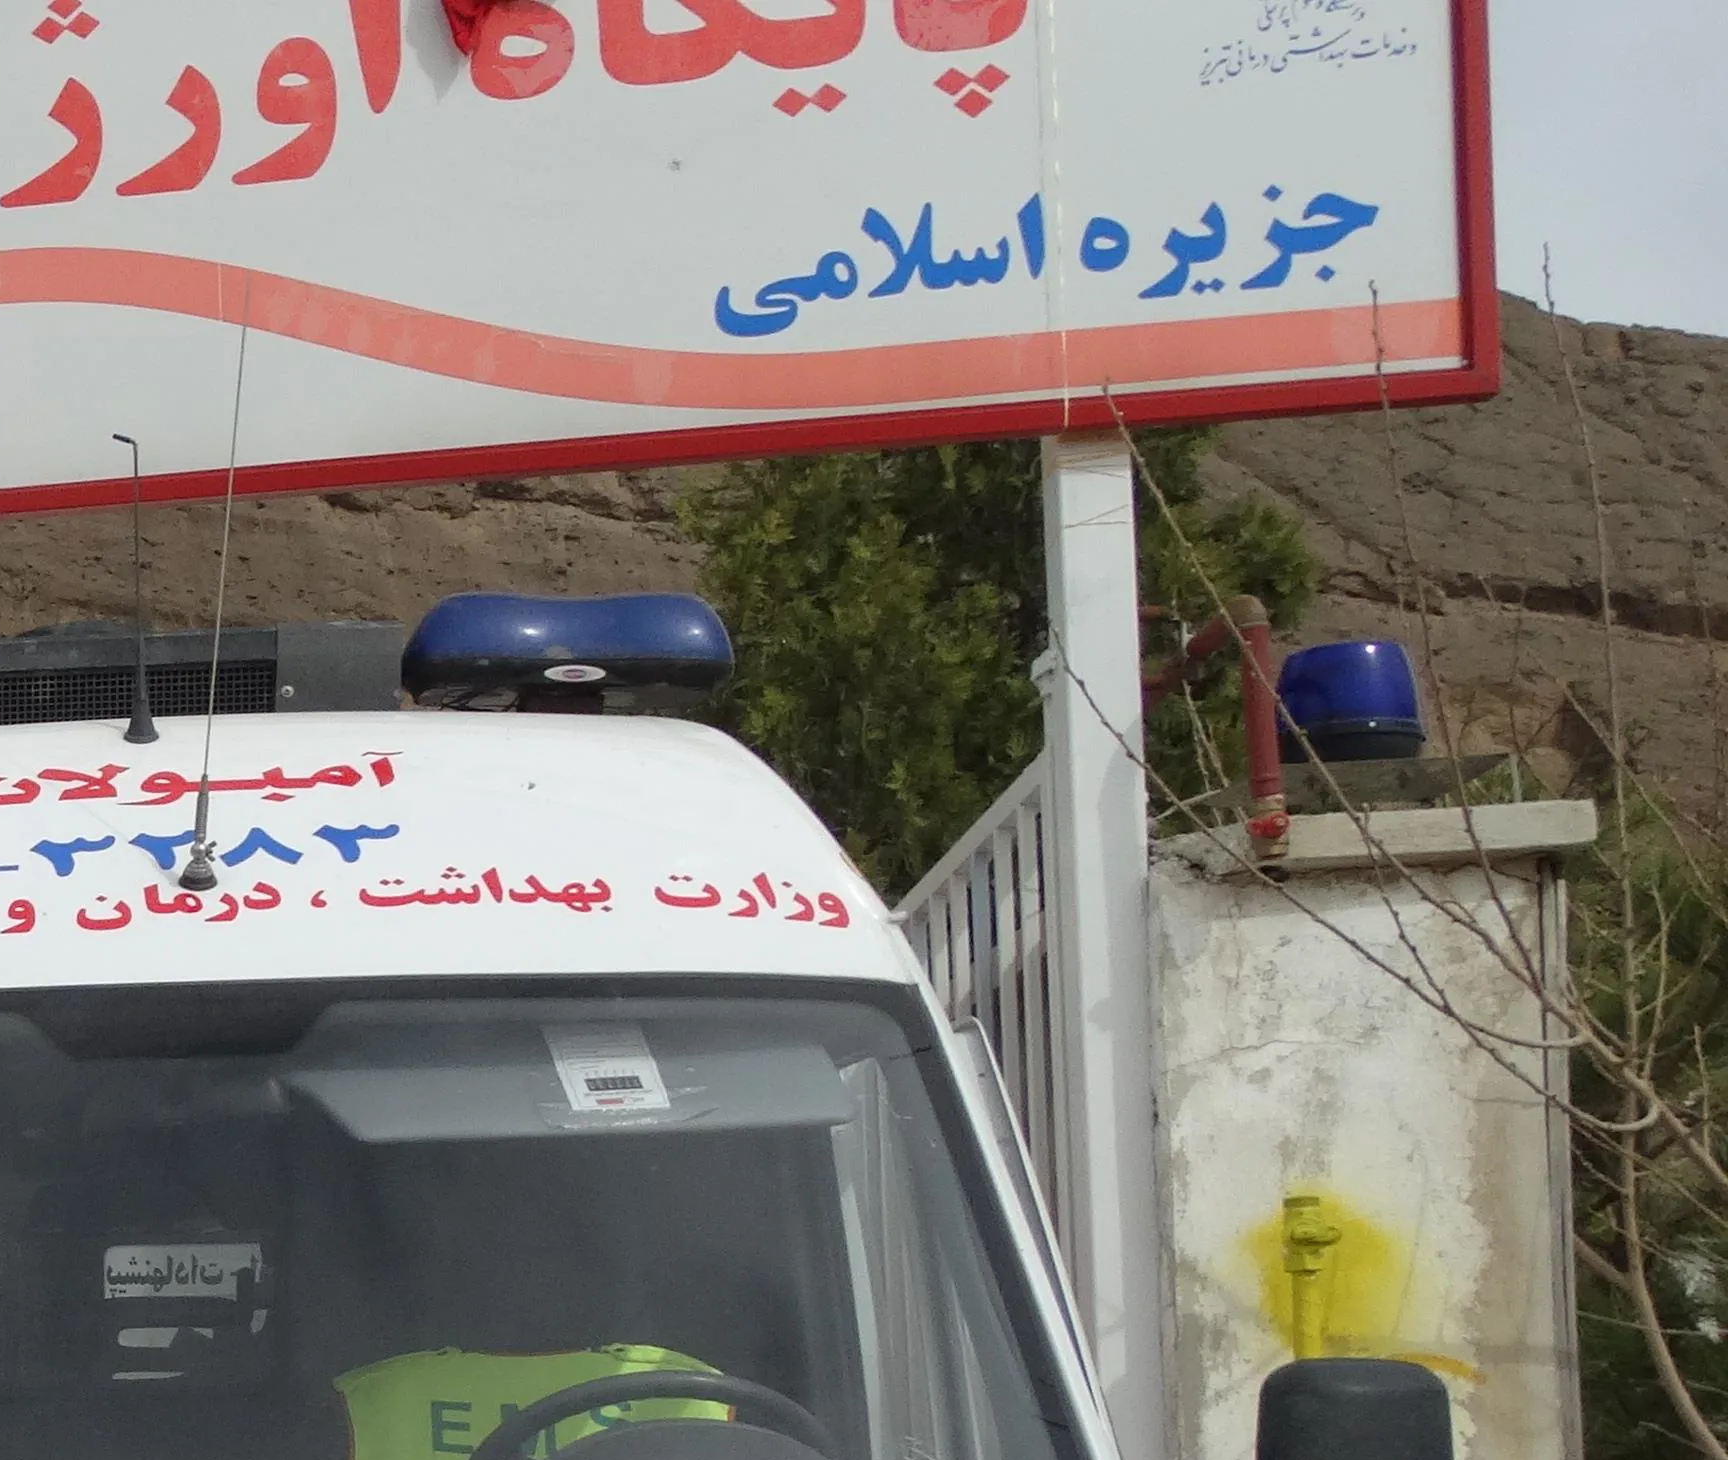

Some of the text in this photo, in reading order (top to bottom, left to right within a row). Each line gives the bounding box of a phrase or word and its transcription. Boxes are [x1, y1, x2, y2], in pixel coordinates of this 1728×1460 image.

[470, 0, 1028, 117] پیاه
[716, 186, 1378, 336] جزیره اسلامی
[1, 899, 36, 934] و
[75, 881, 281, 932] درمان
[358, 866, 613, 913] بهداشت
[654, 872, 851, 929] وزارت
